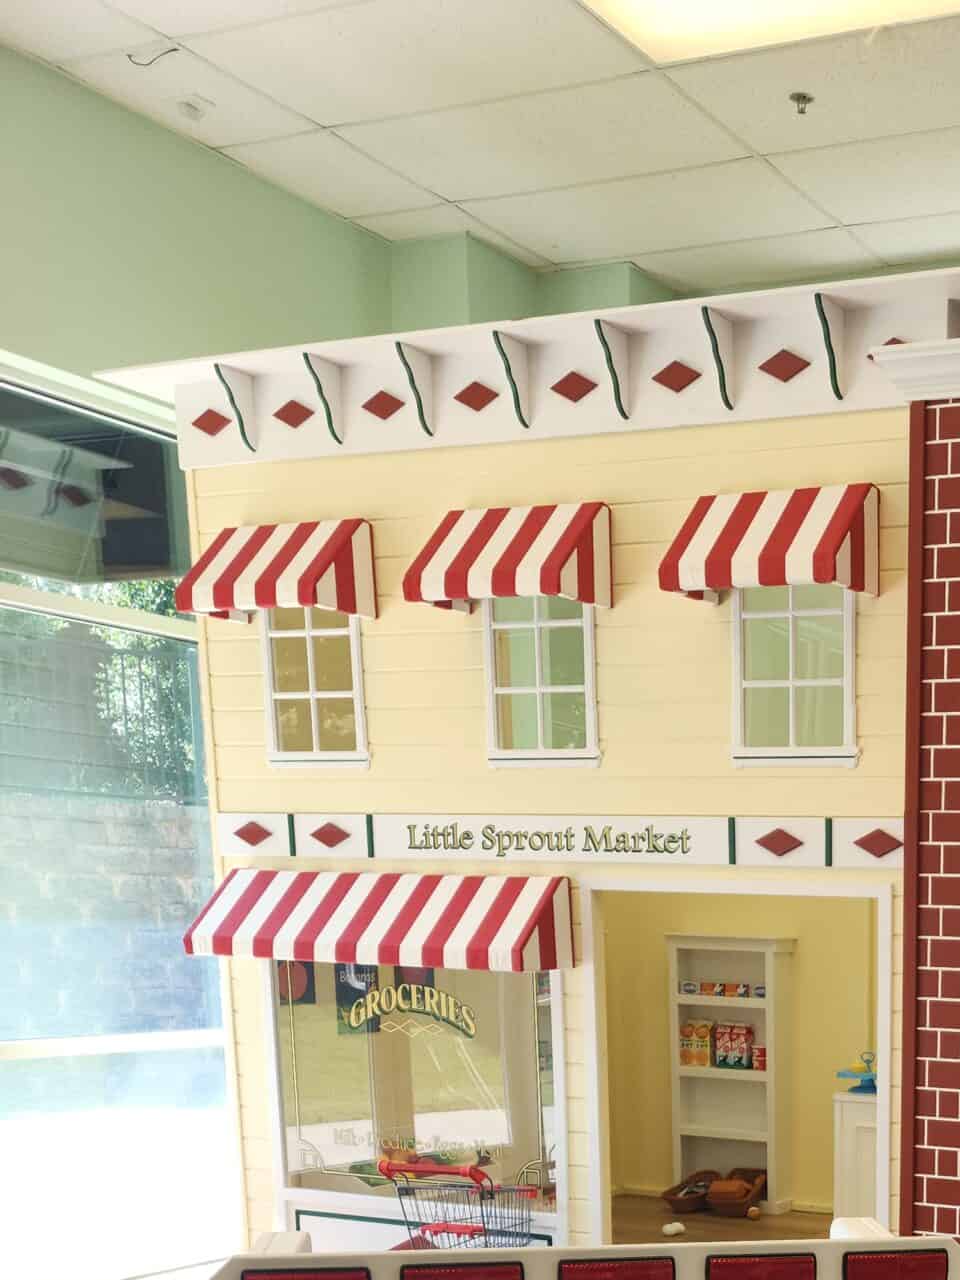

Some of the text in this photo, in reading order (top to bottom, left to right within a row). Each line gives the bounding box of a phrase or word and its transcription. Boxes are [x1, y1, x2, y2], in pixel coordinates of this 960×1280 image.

[406, 822, 691, 856] Little Sprout Market
[350, 983, 477, 1039] GROCERIES
